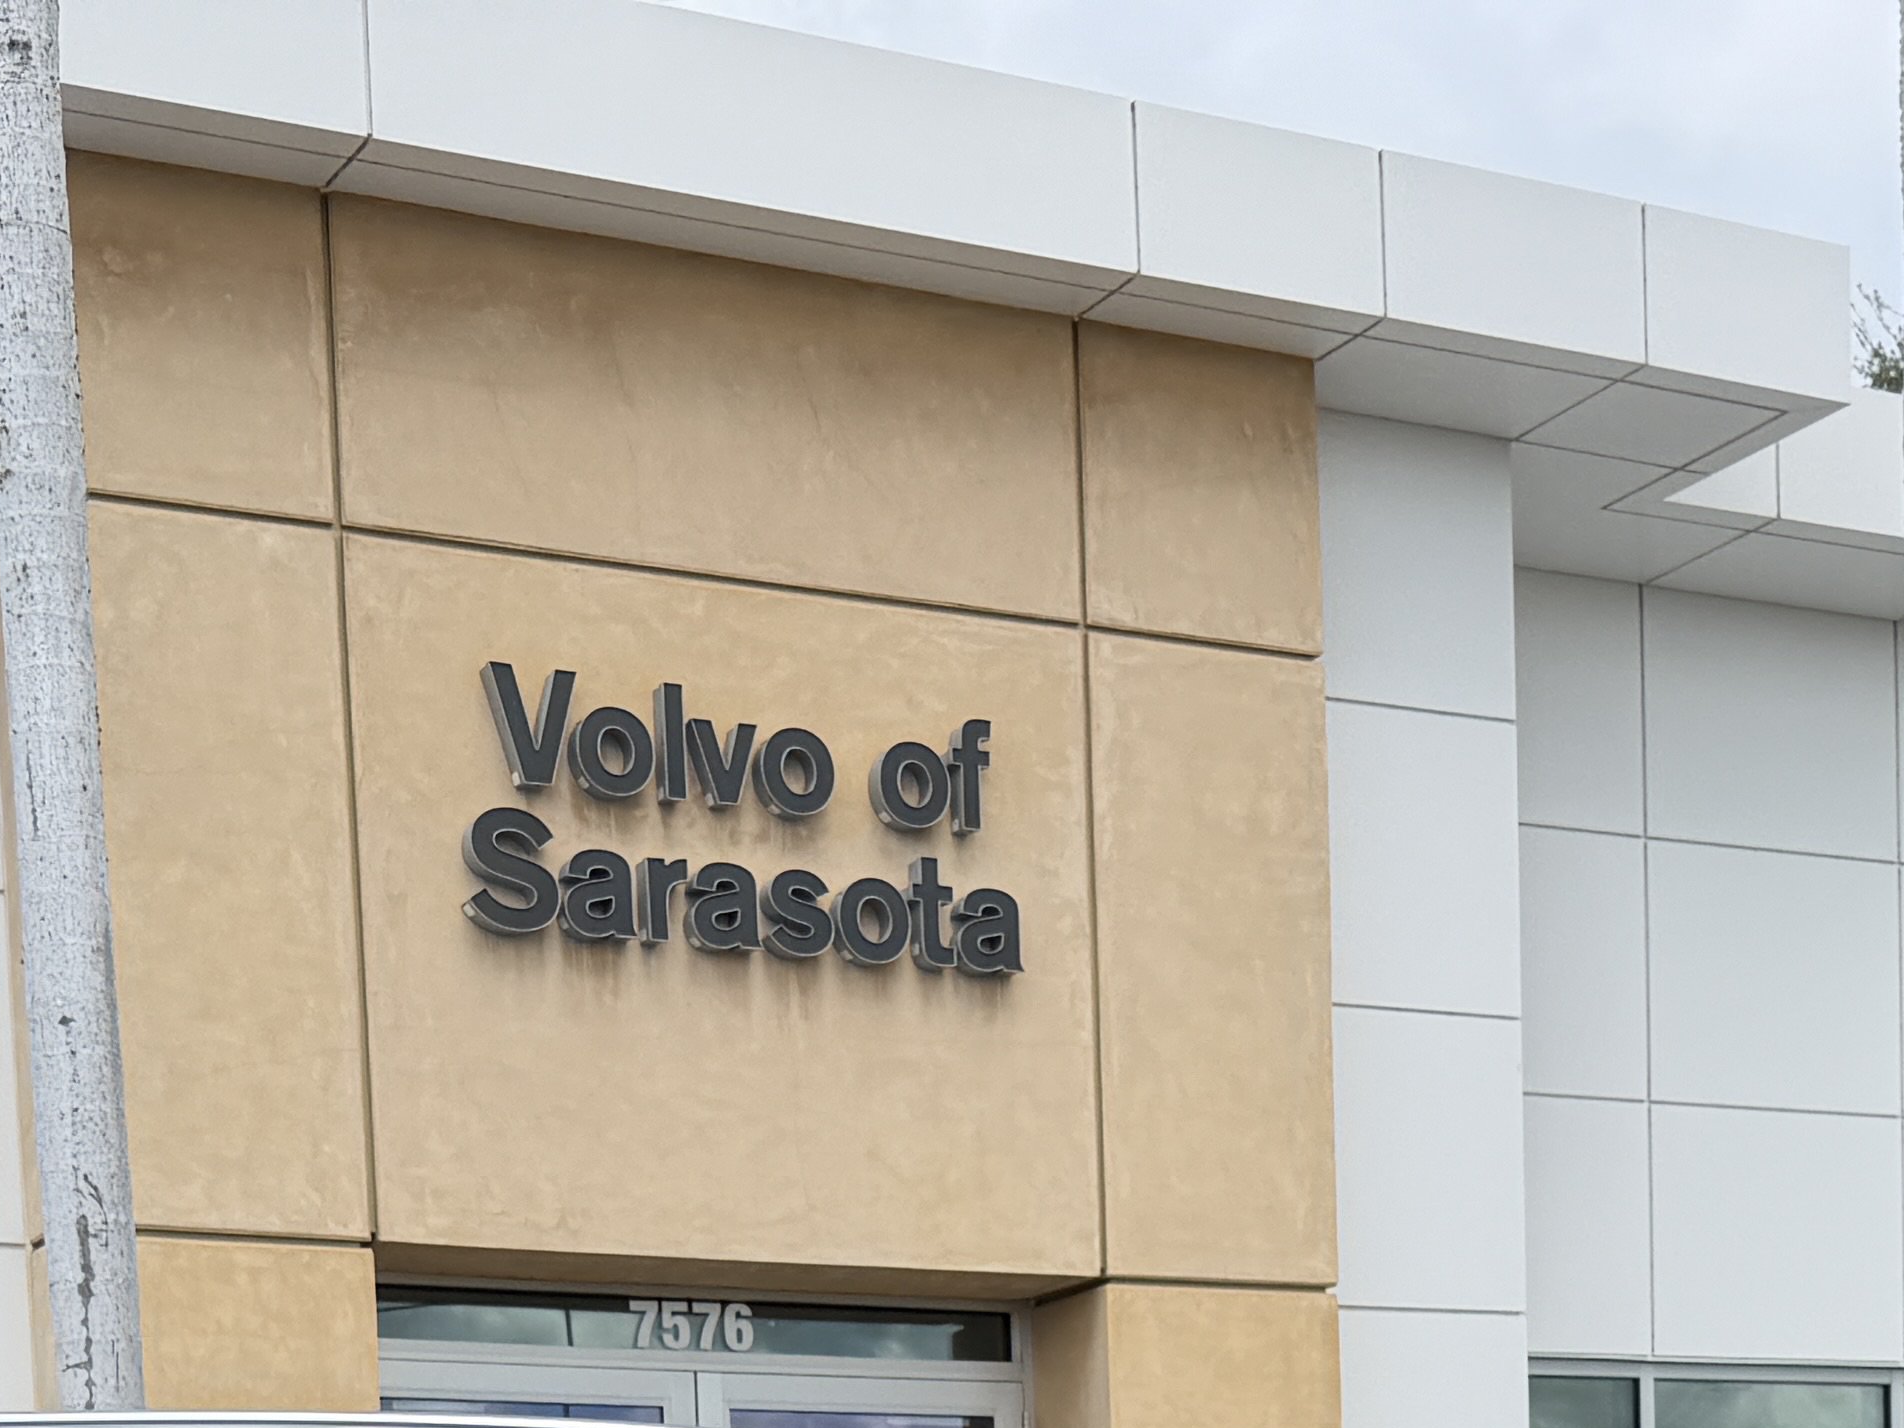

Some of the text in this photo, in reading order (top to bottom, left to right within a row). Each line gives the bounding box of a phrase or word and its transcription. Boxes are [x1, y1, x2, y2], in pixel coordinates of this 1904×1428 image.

[480, 661, 992, 835] Volvo of
[462, 807, 1024, 974] Sarasota
[628, 1300, 754, 1351] 7576
